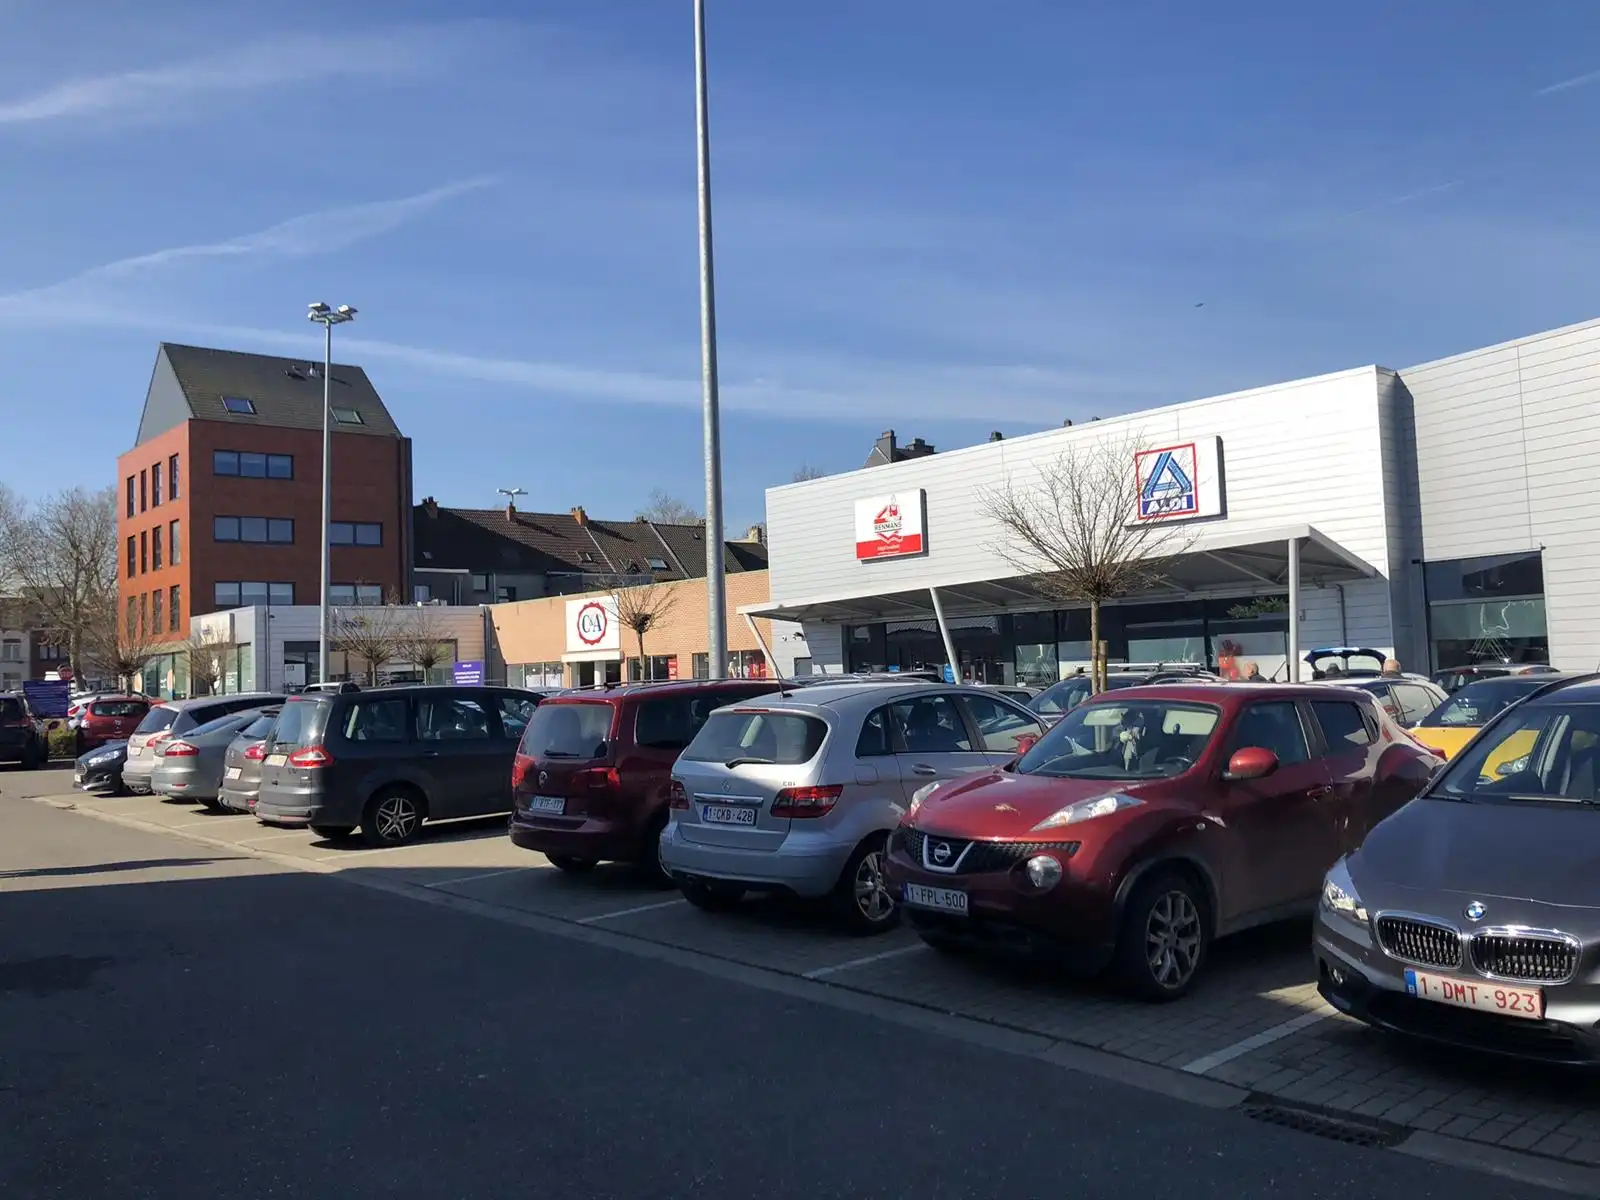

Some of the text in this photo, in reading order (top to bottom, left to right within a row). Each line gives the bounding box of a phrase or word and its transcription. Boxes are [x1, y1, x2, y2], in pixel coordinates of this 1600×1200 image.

[1147, 496, 1188, 514] ALDI
[874, 521, 902, 531] RENMANS
[582, 613, 602, 633] C&A
[909, 887, 966, 909] 1-FPL-500
[1420, 977, 1535, 1013] 1-DMT-923
